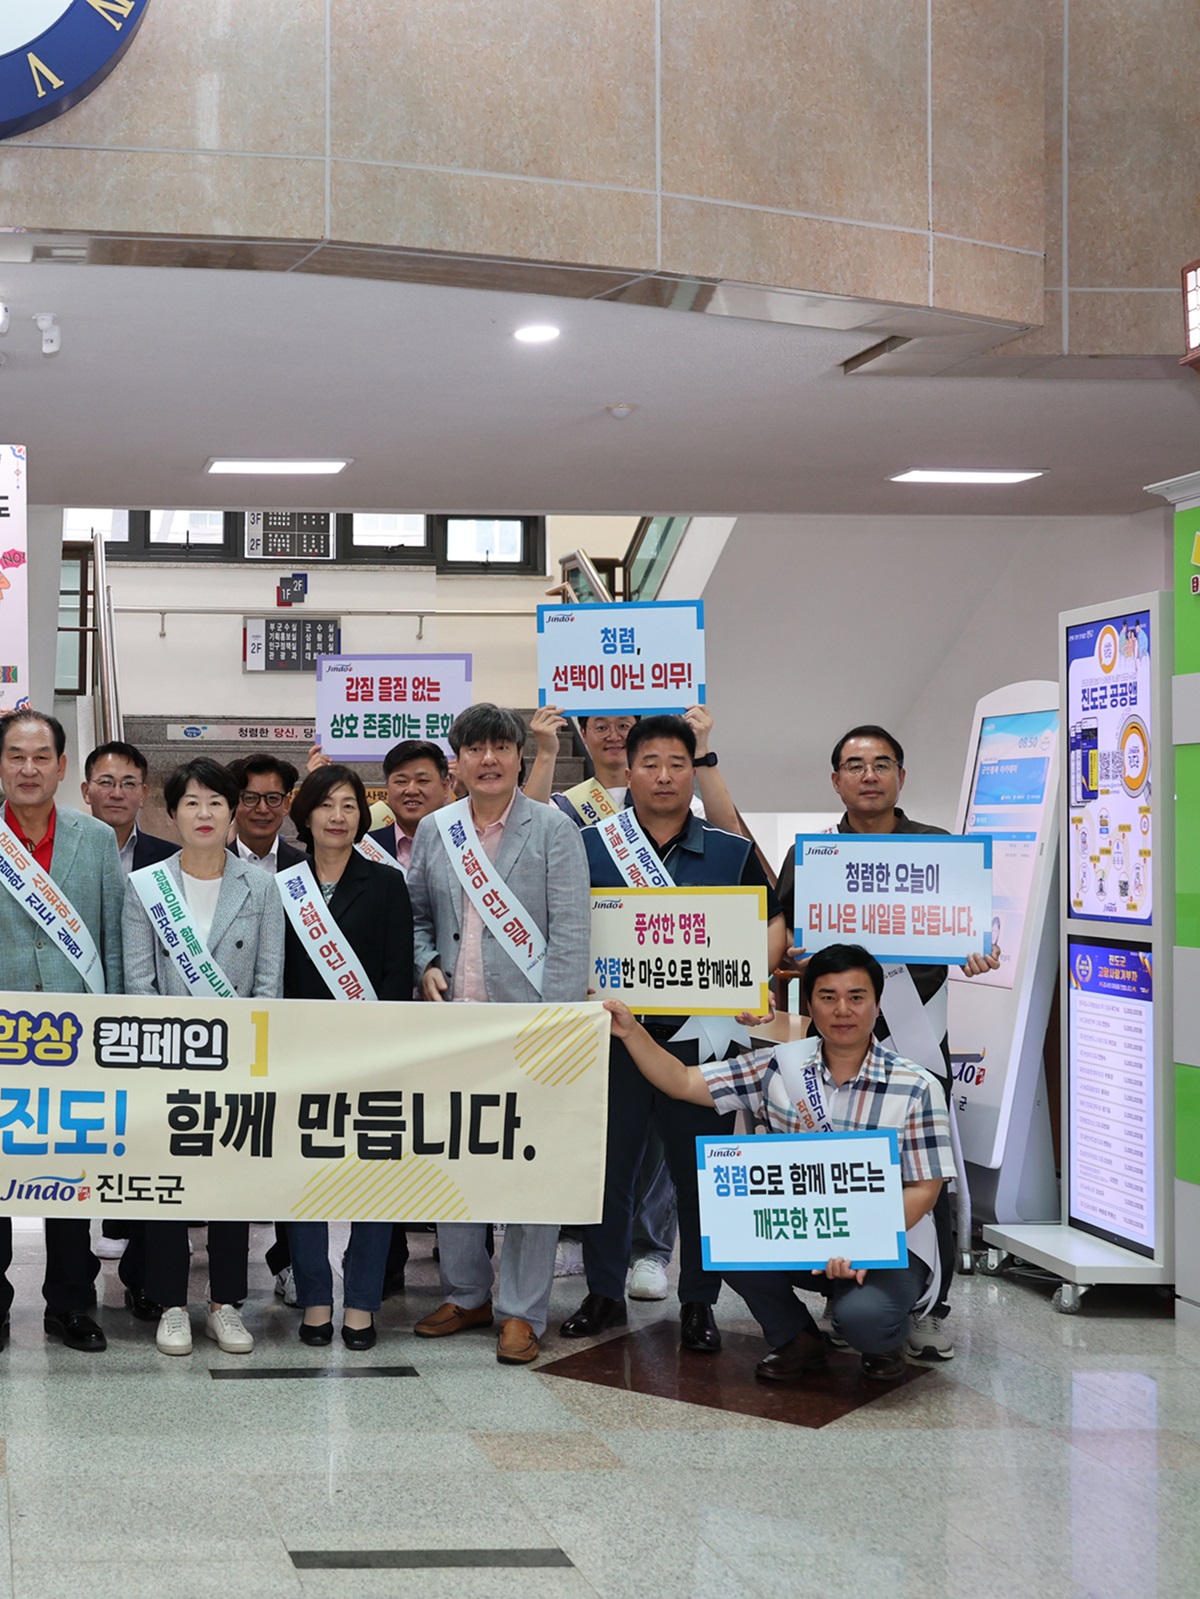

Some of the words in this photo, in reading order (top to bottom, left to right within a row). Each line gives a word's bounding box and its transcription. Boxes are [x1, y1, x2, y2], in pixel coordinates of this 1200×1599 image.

[27, 52, 64, 98] V
[250, 512, 261, 525] 3F
[2, 552, 26, 564] NO!
[250, 538, 261, 551] 2F
[281, 589, 291, 600] 1F
[293, 580, 303, 591] 2F
[251, 643, 262, 654] 2F
[600, 627, 641, 655] 청렴,
[345, 676, 374, 702] 갑질
[378, 676, 407, 702] 을질
[412, 676, 441, 702] 없는
[552, 664, 604, 692] 선택이
[610, 663, 645, 691] 아닌
[651, 663, 692, 690] 의무!
[1081, 685, 1108, 711] 진도군
[1110, 681, 1138, 708] 공공앱
[238, 727, 269, 738] 청렴한
[274, 728, 298, 739] 당신,
[330, 713, 359, 739] 상호
[363, 713, 421, 739] 존중하는
[604, 823, 630, 861] 부패는
[845, 862, 890, 893] 청렴한
[894, 863, 940, 894] 오늘이
[32, 872, 81, 934] 신뢰하는
[151, 868, 186, 923] 청렴으로
[179, 925, 204, 957] 함께
[461, 848, 489, 890] 선택이
[482, 888, 510, 920] 아닌
[502, 917, 534, 958] 의무!
[24, 894, 56, 926] 진도
[56, 927, 83, 960] 실현
[299, 901, 328, 940] 선택이
[318, 940, 347, 971] 아닌
[634, 913, 675, 945] 풍성한
[679, 913, 711, 948] 명절,
[809, 903, 823, 933] 더
[828, 903, 857, 933] 나은
[862, 903, 906, 935] 내일을
[911, 905, 977, 937] 만듭니다.
[149, 901, 180, 948] 깨끗한
[176, 951, 201, 985] 진도
[594, 957, 635, 989] 청렴한
[639, 957, 693, 989] 마음으로
[697, 957, 753, 989] 함께해요
[95, 1018, 229, 1070] 캠페인
[802, 1066, 826, 1122] 신뢰하고
[166, 1089, 276, 1158] 함께
[298, 1090, 536, 1162] 만듭니다.
[796, 1099, 815, 1130] 직장
[0, 1175, 76, 1203] Jindo
[96, 1173, 185, 1205] 진도군
[713, 1165, 785, 1197] 청렴으로
[789, 1163, 826, 1195] 함께
[831, 1161, 885, 1194] 만드는
[753, 1206, 808, 1240] 깨끗한
[813, 1206, 850, 1239] 진도
